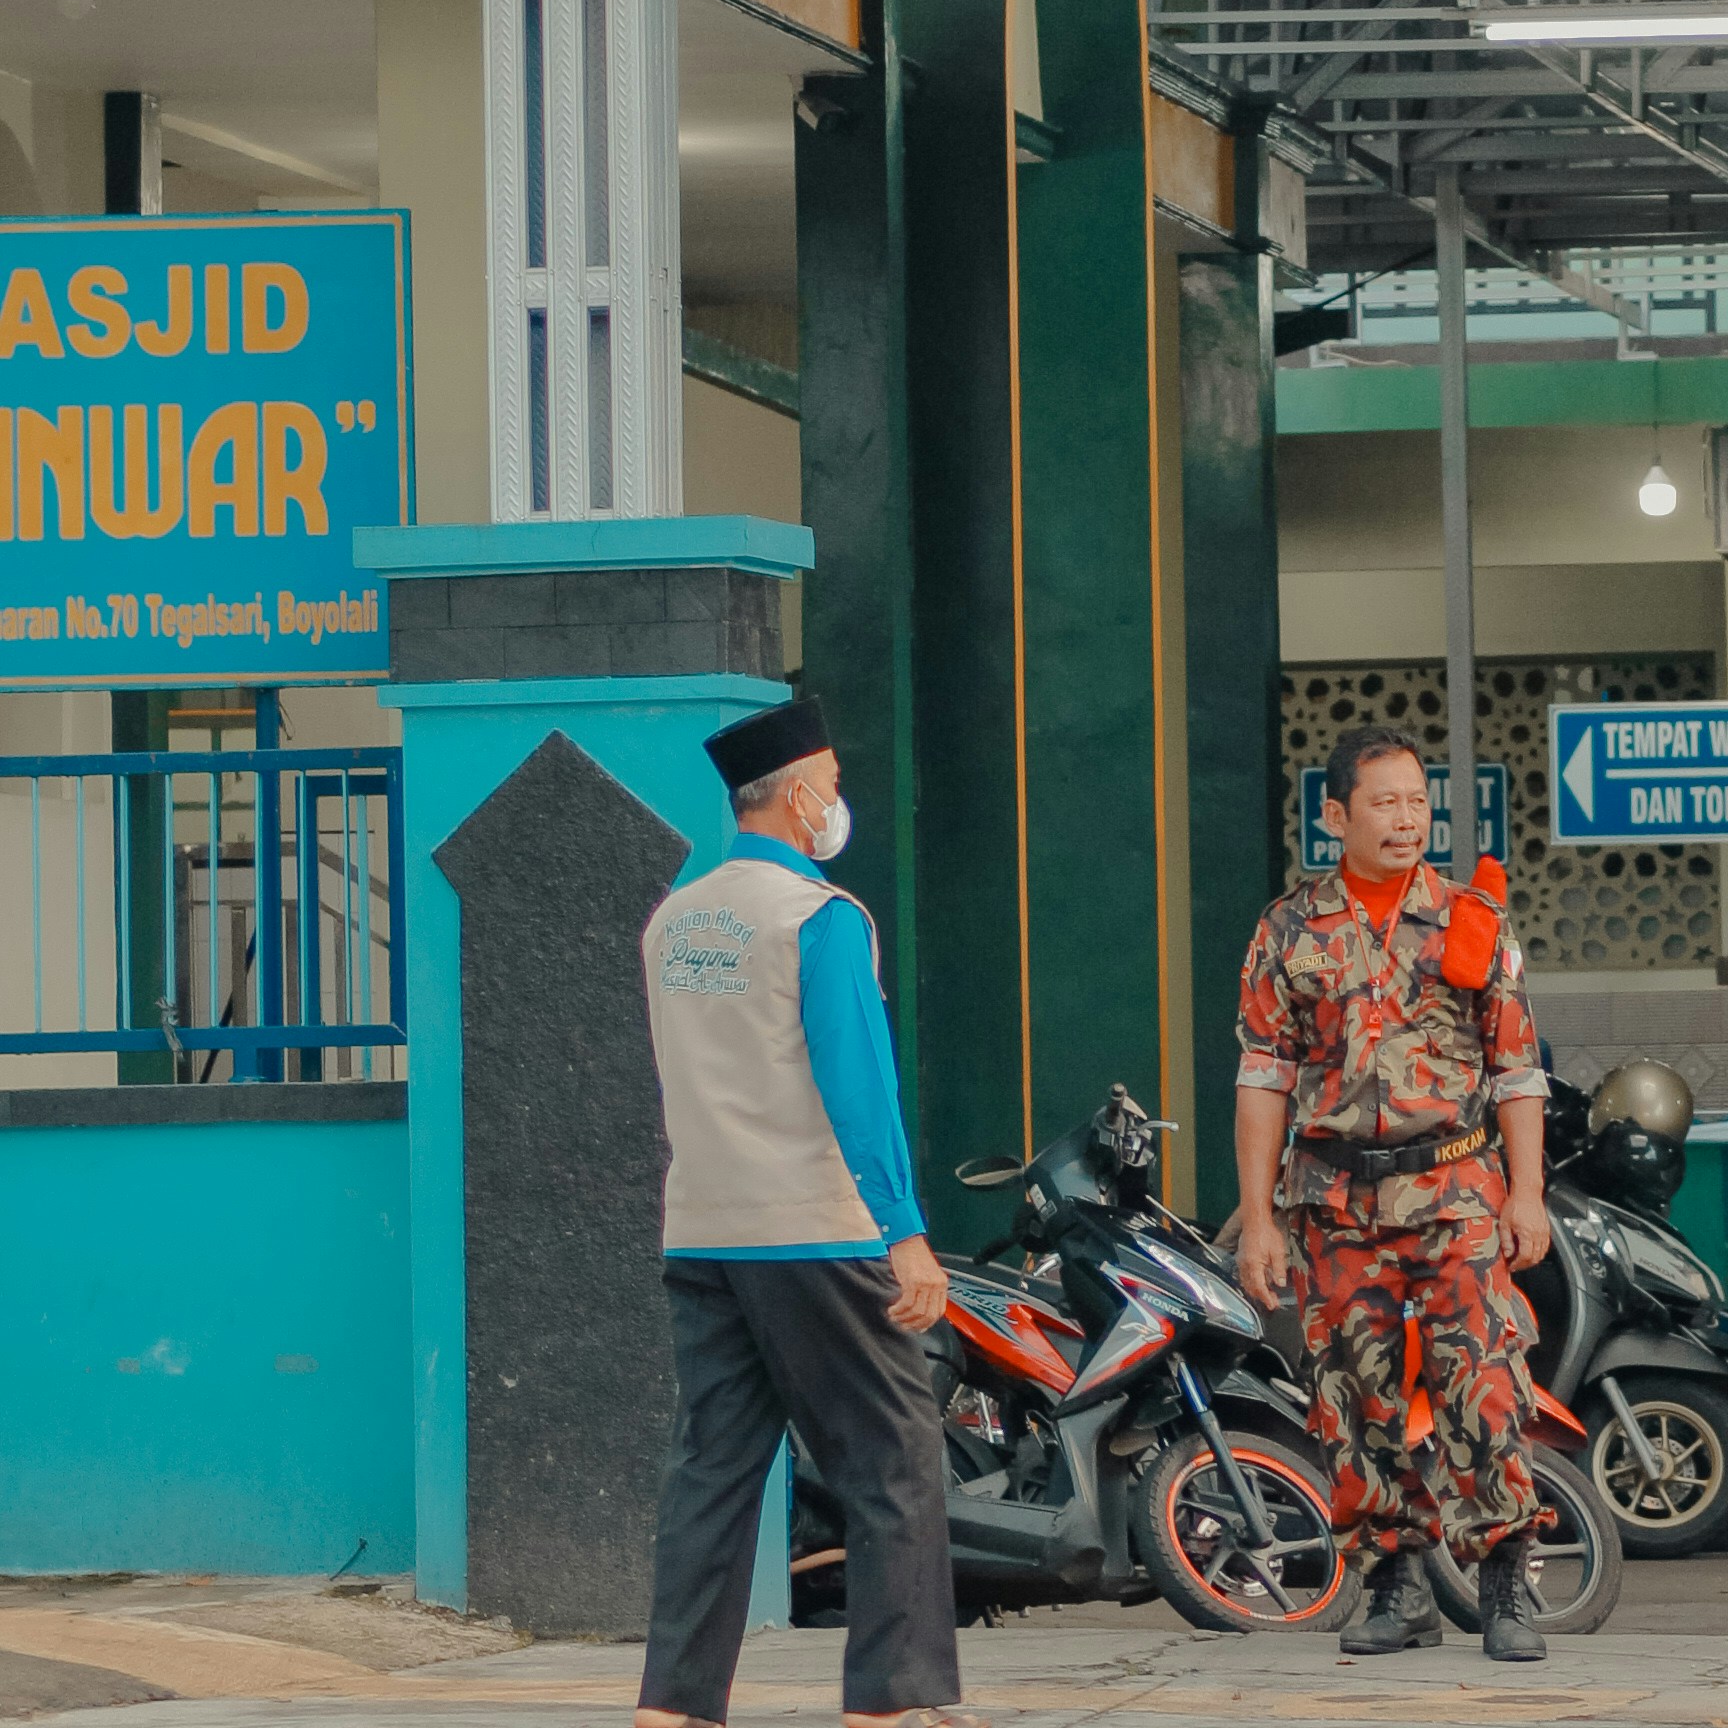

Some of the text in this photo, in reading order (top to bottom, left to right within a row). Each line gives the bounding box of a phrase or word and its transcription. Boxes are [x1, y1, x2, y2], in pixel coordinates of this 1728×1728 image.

[66, 593, 139, 639] No.70
[145, 591, 271, 649] Tegalsari,
[277, 588, 379, 646] Boyolali
[1603, 720, 1703, 759] TEMPAT
[1631, 786, 1683, 824] DAN
[664, 906, 757, 949] Kajian Ahad
[665, 936, 741, 975] Pagimu
[1441, 1127, 1487, 1162] KOKAM
[1142, 1292, 1190, 1323] HONDA
